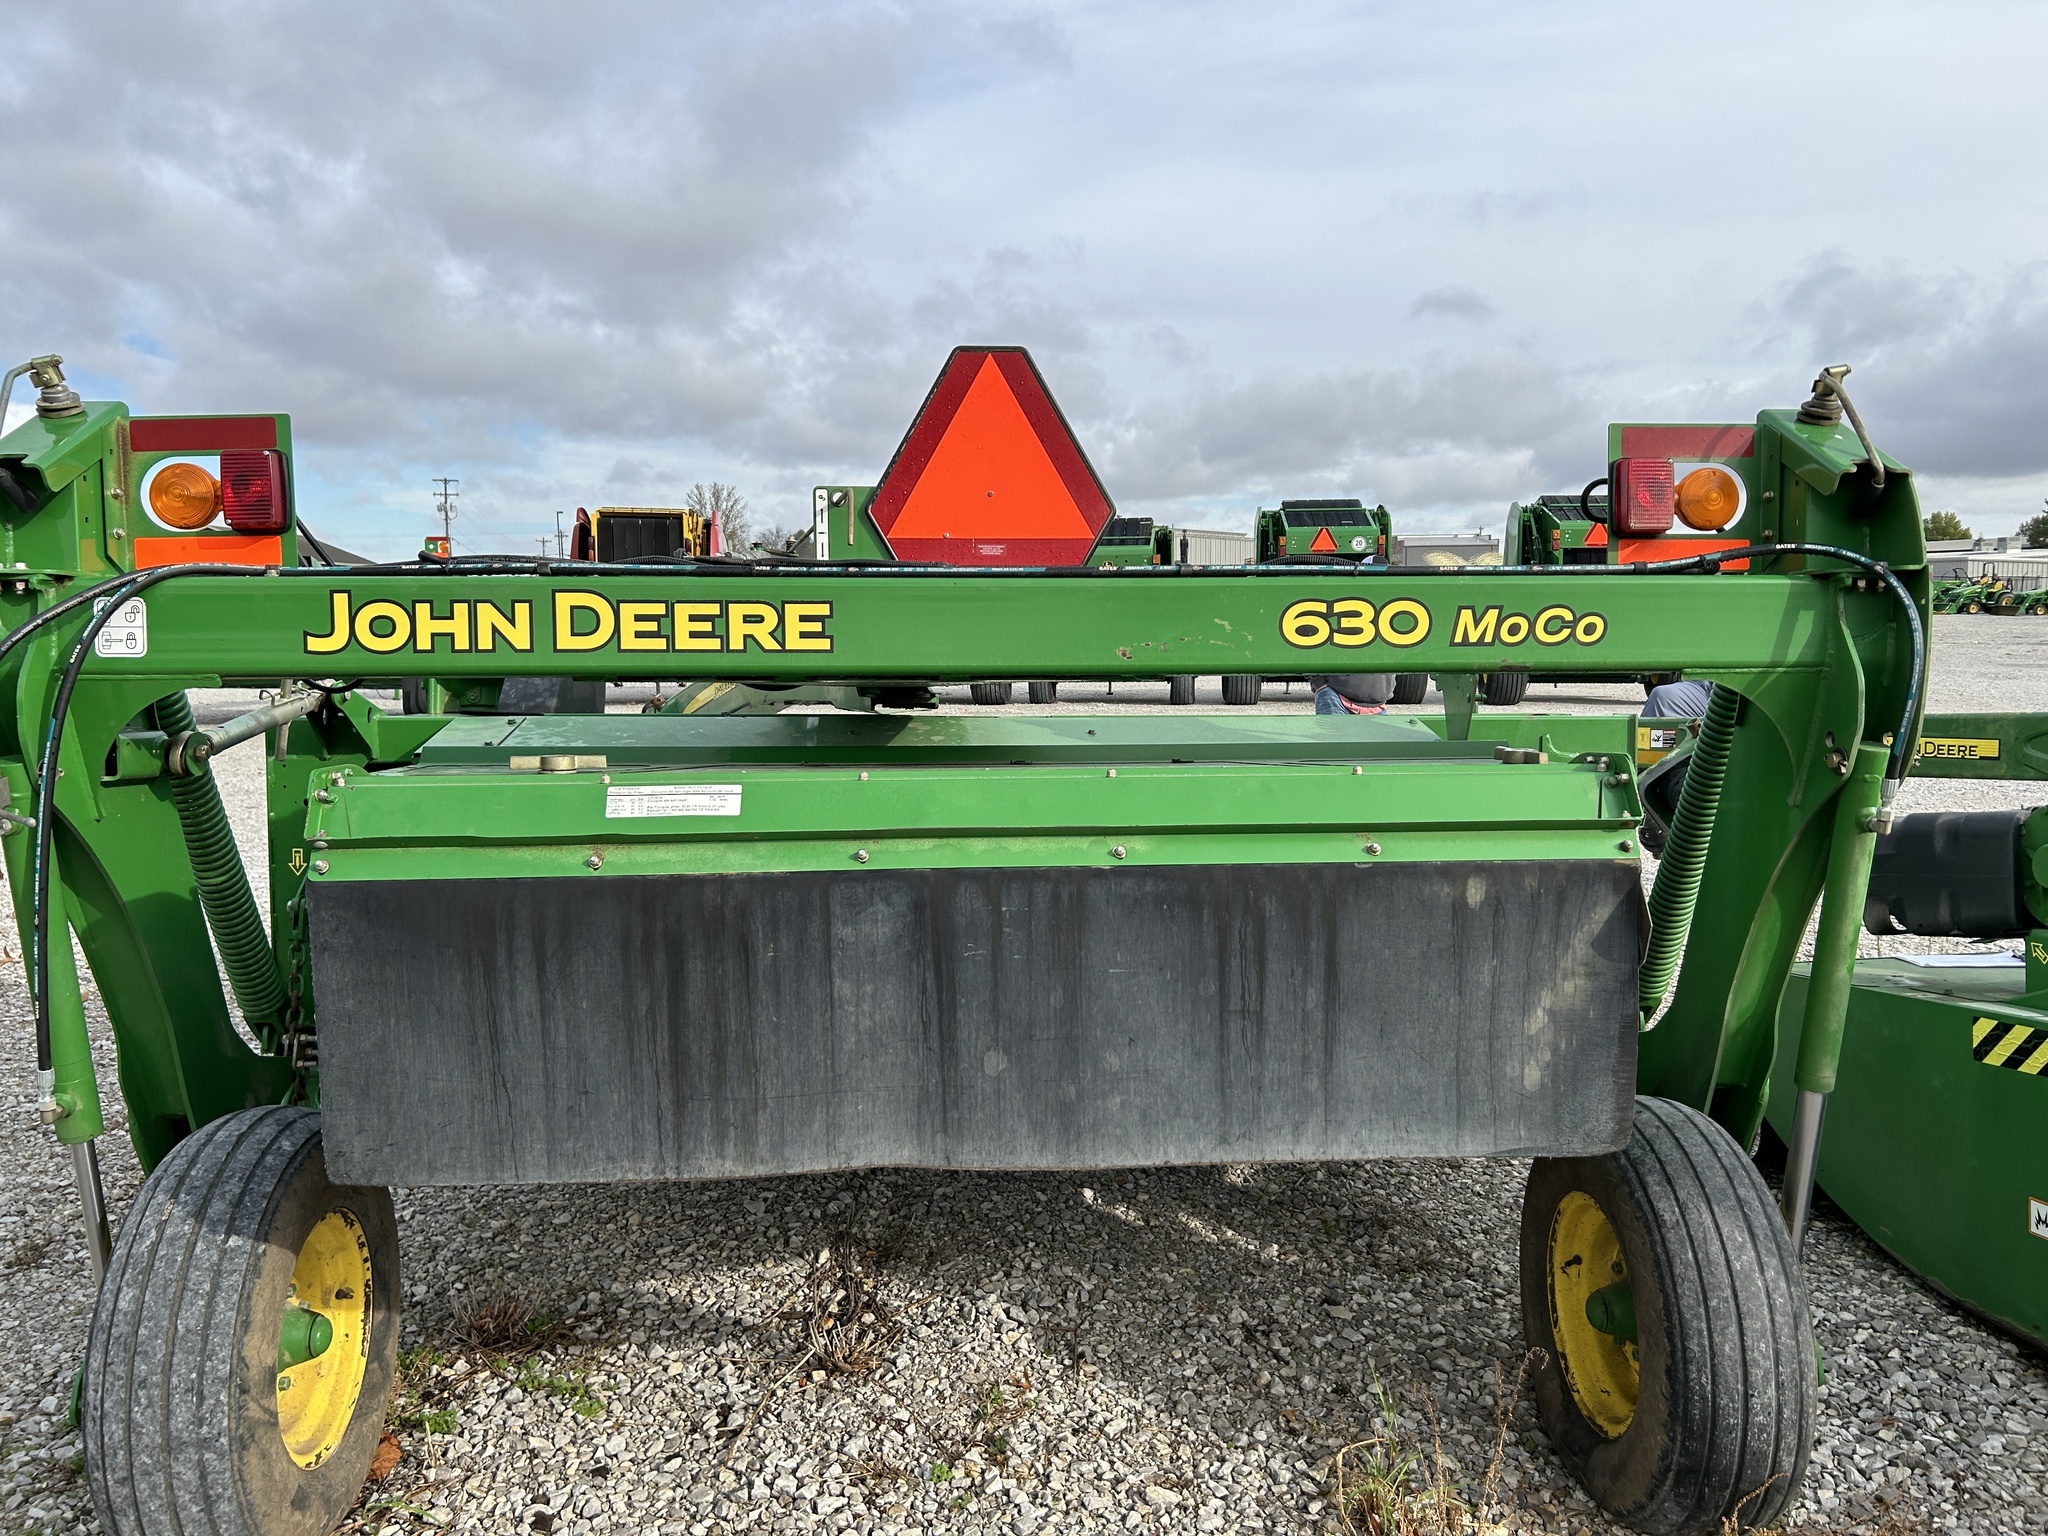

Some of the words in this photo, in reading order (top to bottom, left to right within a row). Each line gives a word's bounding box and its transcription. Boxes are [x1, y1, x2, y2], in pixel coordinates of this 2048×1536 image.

[304, 589, 534, 655] JOHN
[551, 588, 834, 654] DEERE
[1279, 597, 1432, 649] 630
[1450, 604, 1608, 647] MoCo
[69, 644, 81, 663] GATES
[1924, 741, 1979, 757] DEERE
